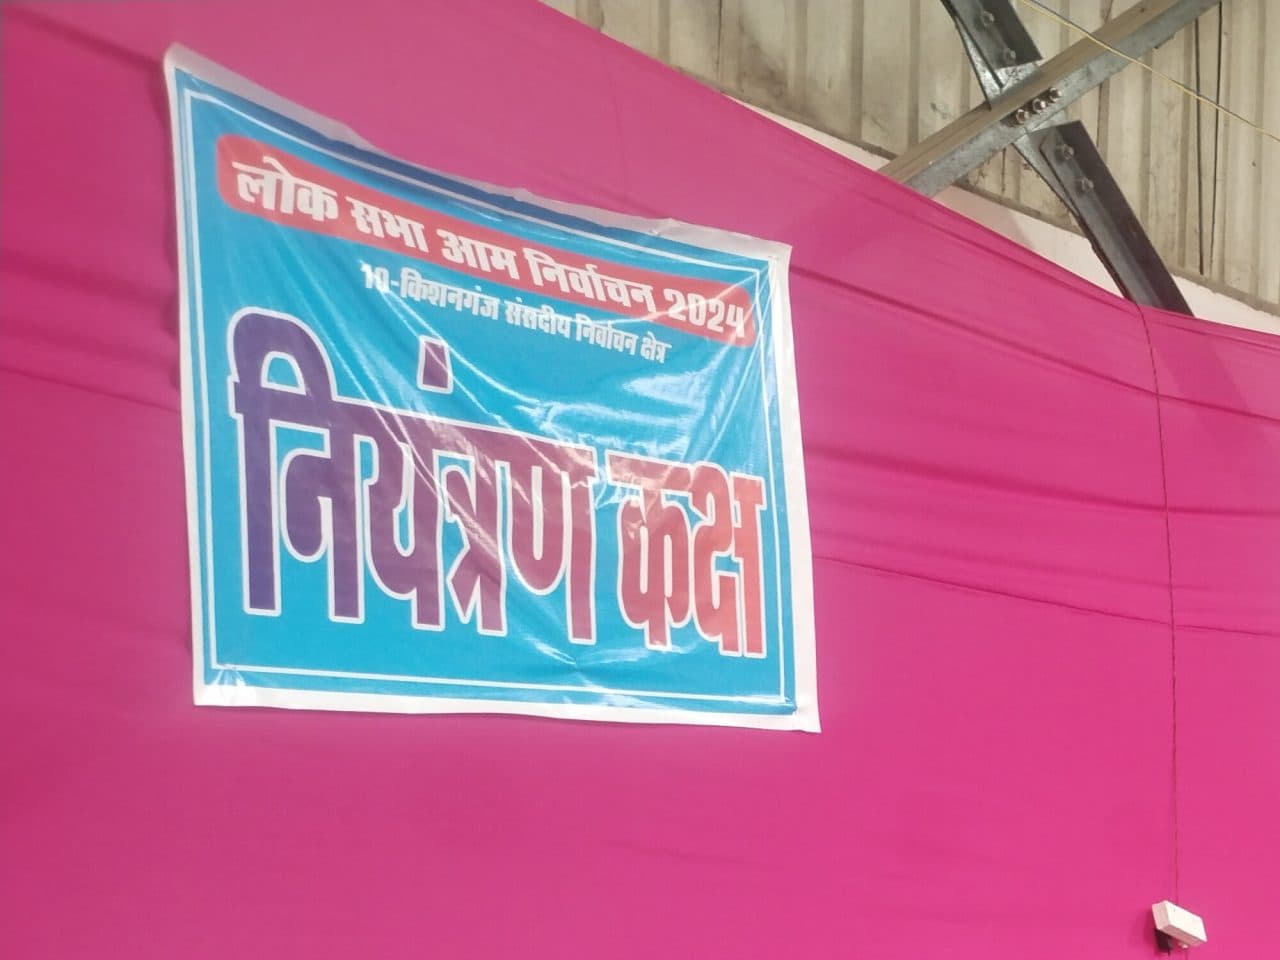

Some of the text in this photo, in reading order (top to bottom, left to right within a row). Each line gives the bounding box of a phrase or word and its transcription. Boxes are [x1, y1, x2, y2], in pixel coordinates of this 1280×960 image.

[232, 156, 746, 338] लोक सभा आम निर्वाचन 2024
[360, 262, 672, 364] 10-किशनगंज संसदीय निर्वाचन क्षेत्र
[227, 306, 766, 658] नियंत्रण कक्ष
